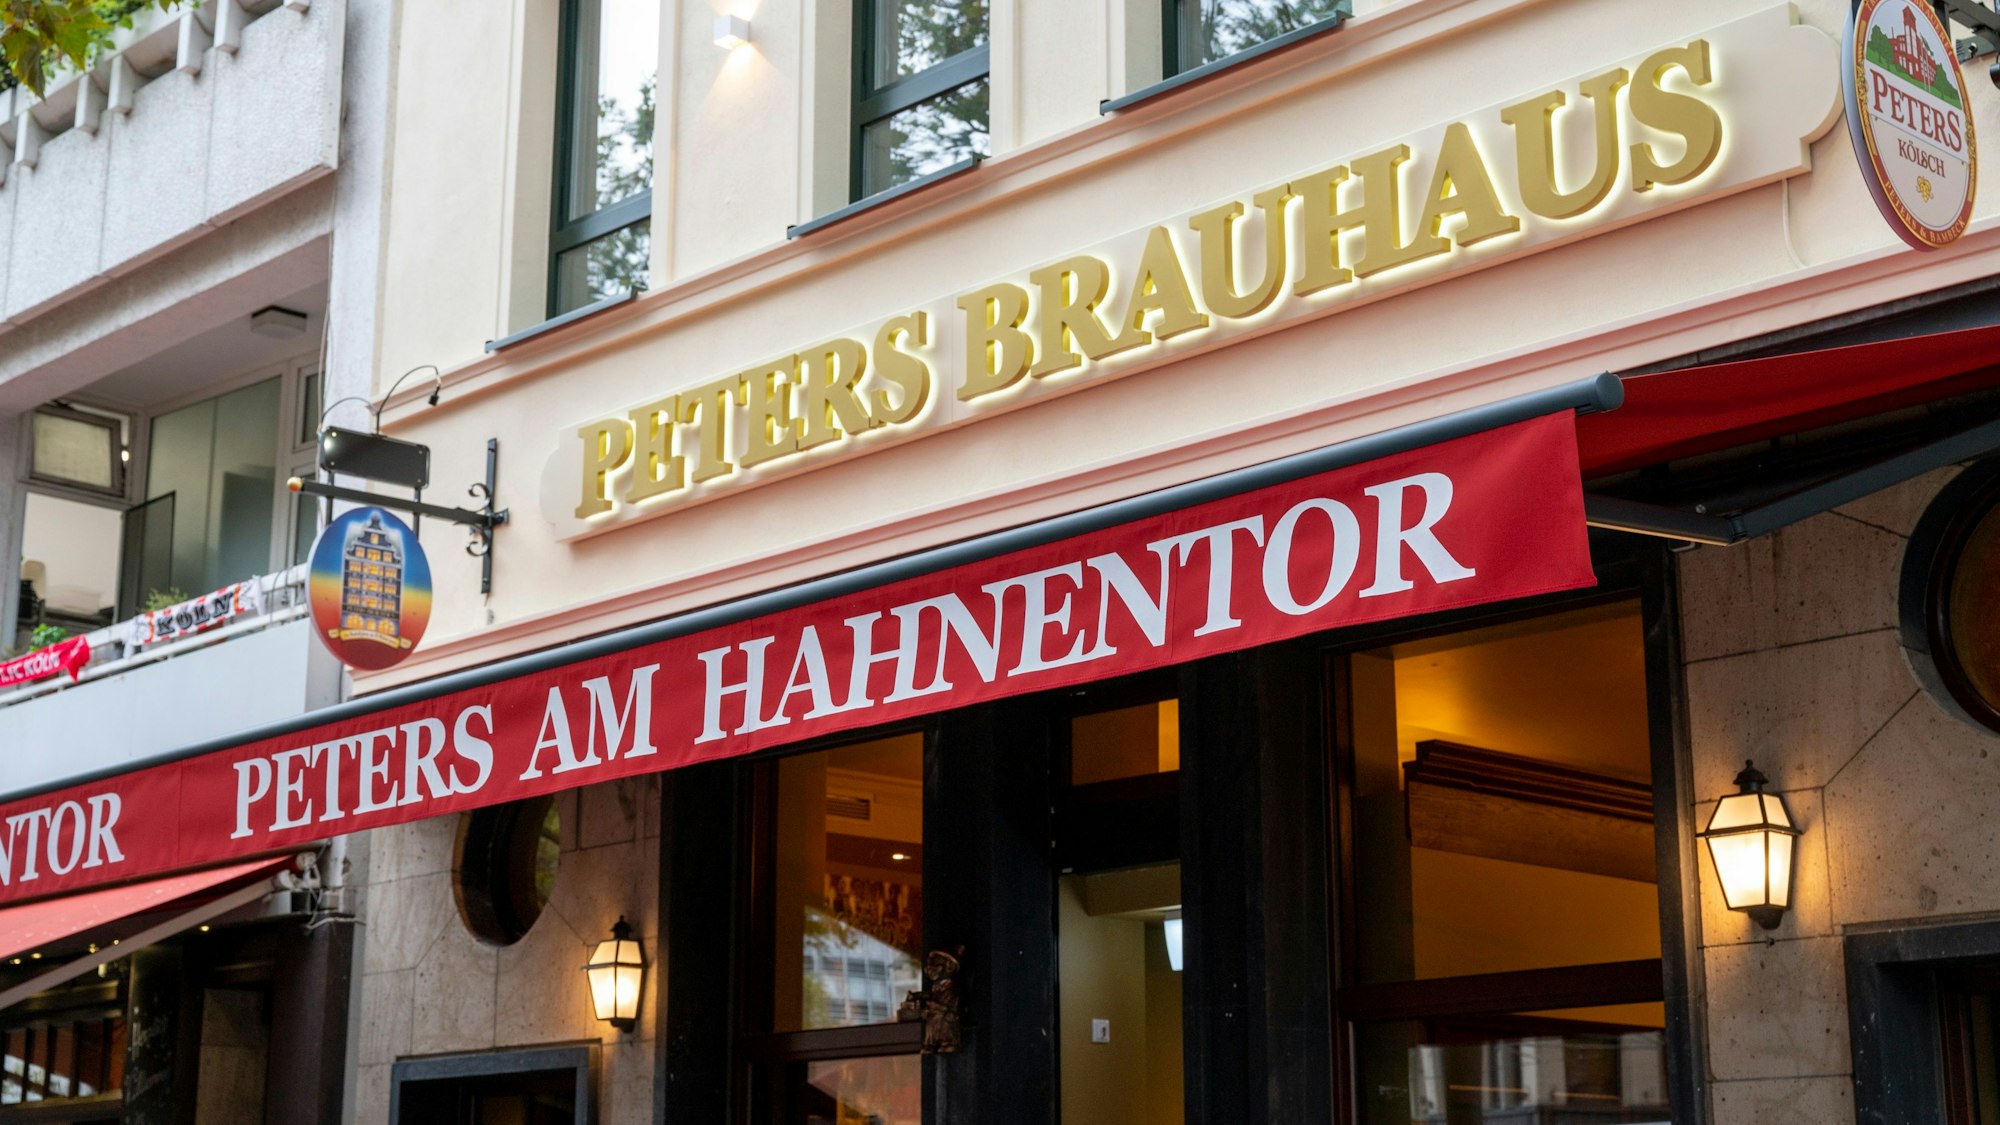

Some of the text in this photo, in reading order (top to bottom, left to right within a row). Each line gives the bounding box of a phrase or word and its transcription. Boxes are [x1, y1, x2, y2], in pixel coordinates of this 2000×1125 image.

[1869, 68, 1962, 152] PETERS
[1897, 138, 1946, 178] KÖLSCH
[1885, 181, 1966, 243] PETERS & BAMBECK
[575, 38, 1723, 519] PETERS BRAUHAUS
[156, 591, 234, 636] KÖLN
[231, 472, 1476, 839] PETERS AM HAHNENTOR
